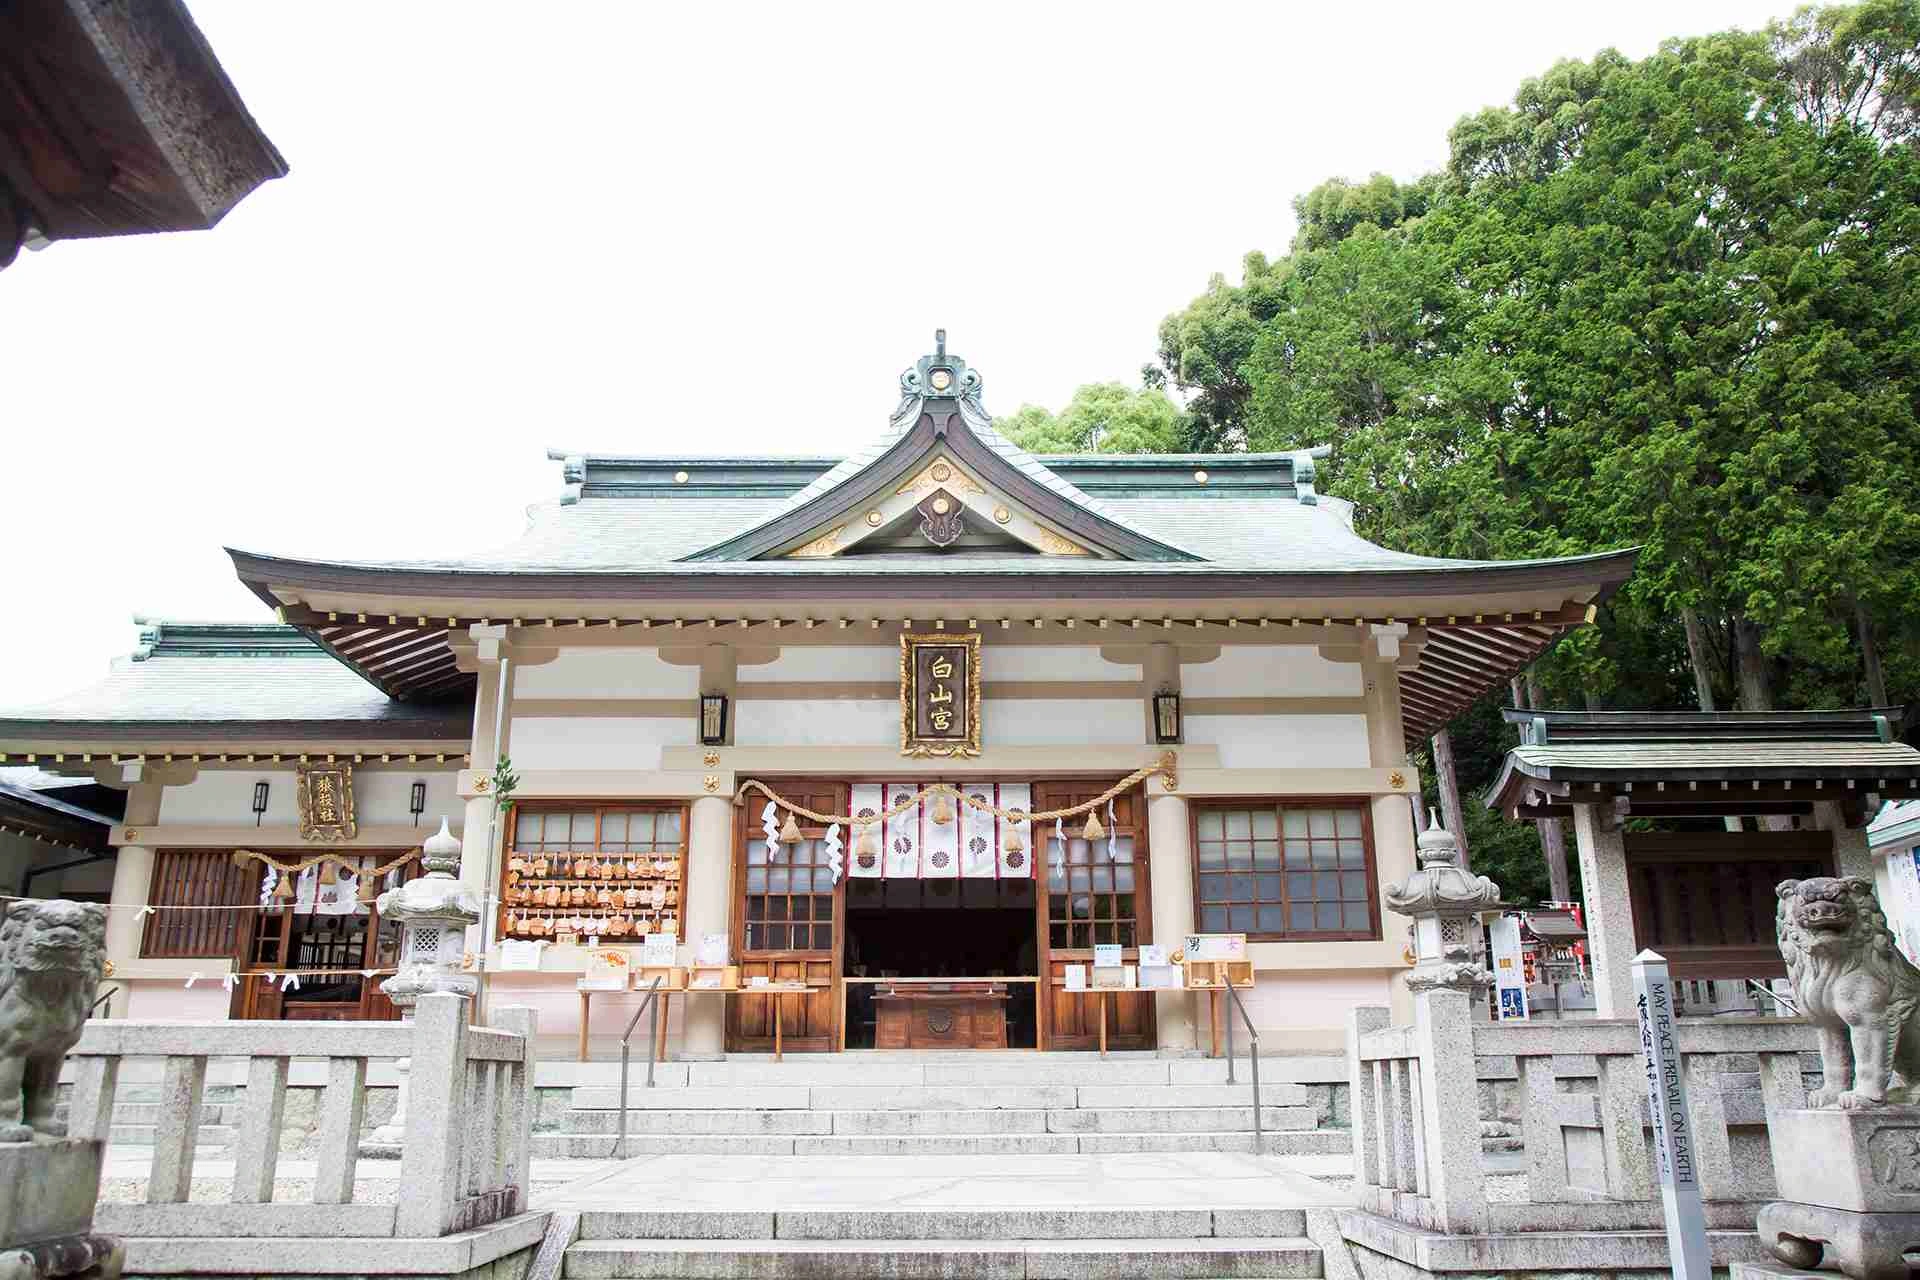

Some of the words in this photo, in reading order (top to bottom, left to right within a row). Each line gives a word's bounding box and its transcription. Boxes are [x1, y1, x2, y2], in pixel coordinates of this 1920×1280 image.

[929, 655, 953, 730] 白山宮
[1652, 983, 1667, 1011] MAY
[1657, 1014, 1674, 1055] PEACE
[1637, 994, 1669, 1173] 世界人類平和りすう
[1663, 1059, 1681, 1111] PREVAIL
[1670, 1112, 1685, 1133] ON
[1674, 1136, 1693, 1183] EARTH
